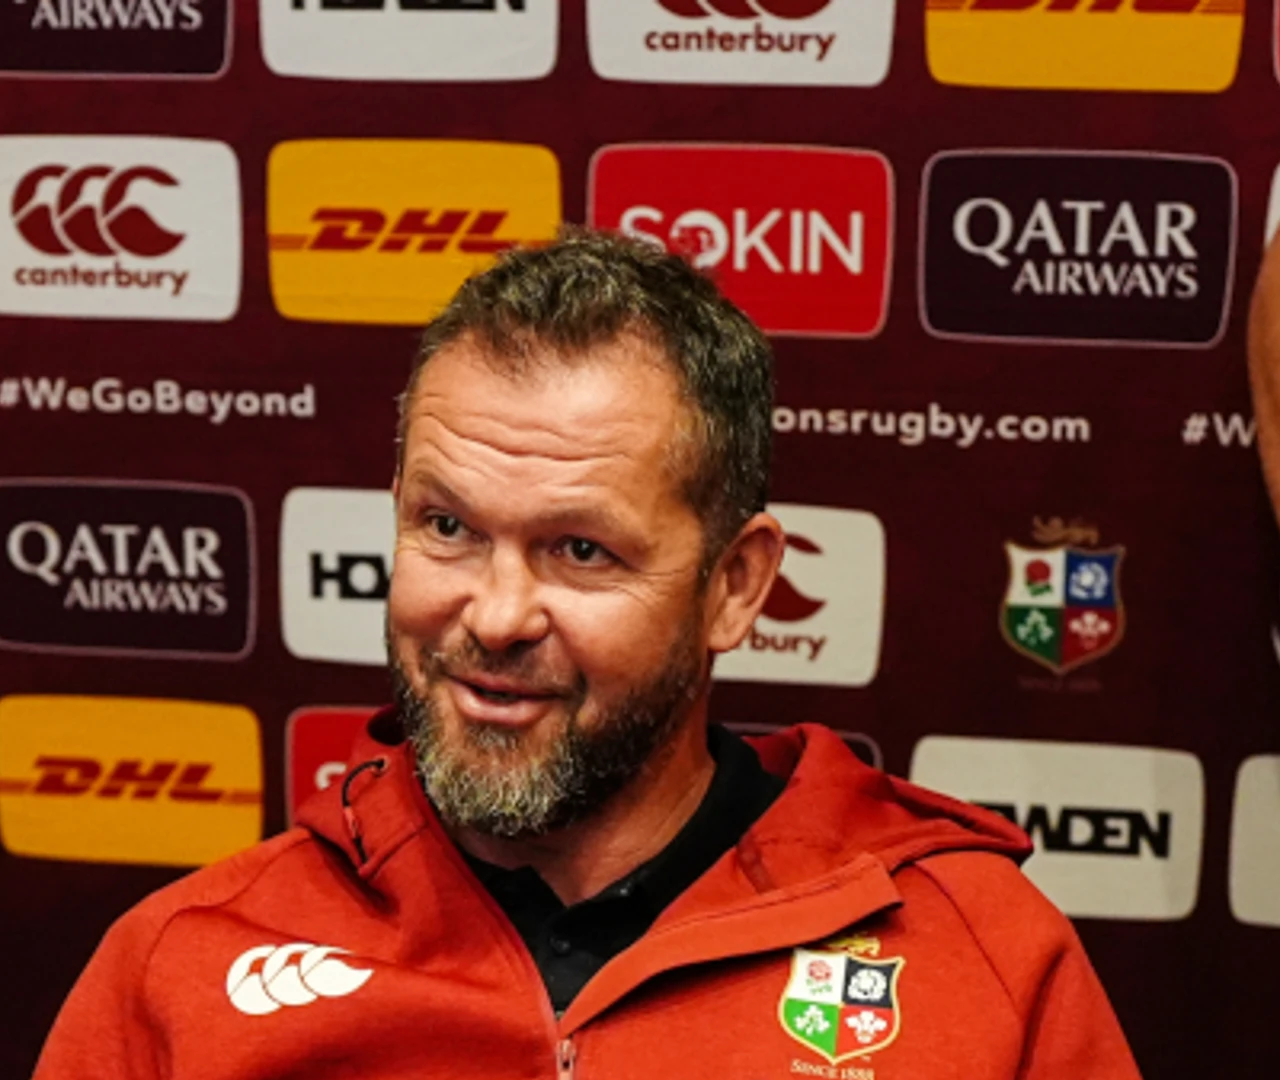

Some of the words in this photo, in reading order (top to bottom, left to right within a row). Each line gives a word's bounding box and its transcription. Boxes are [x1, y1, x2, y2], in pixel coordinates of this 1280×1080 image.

[31, 0, 202, 30] AIRWAYS
[645, 22, 836, 61] canterbury
[310, 208, 520, 254] DHL
[619, 205, 865, 275] SOKIN
[953, 198, 1198, 267] QATAR
[14, 261, 190, 296] canterbury
[1013, 261, 1198, 298] AIRWAYS
[769, 402, 1091, 447] onsrugby.com
[7, 520, 222, 585] QATAR
[65, 580, 227, 615] AIRWAYS
[32, 757, 228, 803] DHL
[972, 800, 1170, 858] WDEN
[790, 1059, 838, 1079] SINCE
